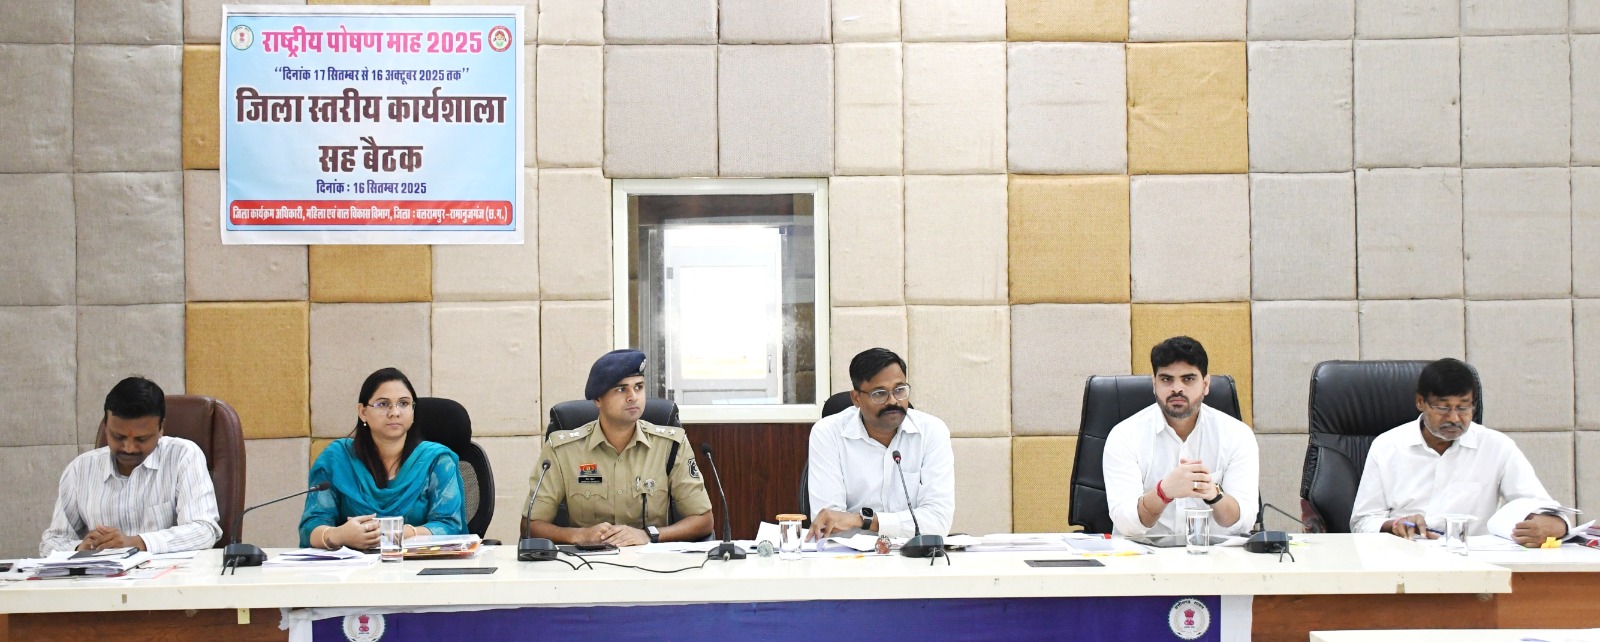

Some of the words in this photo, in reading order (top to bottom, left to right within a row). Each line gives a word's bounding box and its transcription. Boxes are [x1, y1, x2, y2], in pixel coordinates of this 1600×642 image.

[262, 25, 323, 58] राष्ट्रीय
[327, 25, 383, 53] पोषण
[387, 31, 422, 53] माह
[427, 32, 482, 53] 2025
[313, 70, 325, 81] 17
[327, 67, 359, 81] सितम्बर
[361, 67, 368, 81] से
[372, 70, 383, 81] 16
[385, 69, 417, 85] अक्टूबर
[420, 70, 444, 81] 2025
[236, 88, 304, 124] जिला
[309, 88, 383, 123] स्तरीय
[387, 87, 506, 124] कार्यशाला
[319, 145, 358, 173] सह
[359, 136, 423, 173] बैठक
[316, 180, 345, 194] दिनांक
[353, 183, 364, 194] 16
[367, 180, 399, 194] सितम्बर
[401, 183, 427, 194] 2025
[233, 206, 249, 219] जिला
[251, 206, 274, 220] कार्यक्रम
[275, 206, 305, 221] अधिकारी,
[306, 206, 325, 219] महिला
[327, 206, 337, 219] एवं
[337, 208, 349, 219] बाल
[350, 206, 370, 219] विकास
[371, 206, 392, 221] विभाग,
[393, 205, 410, 219] जिला
